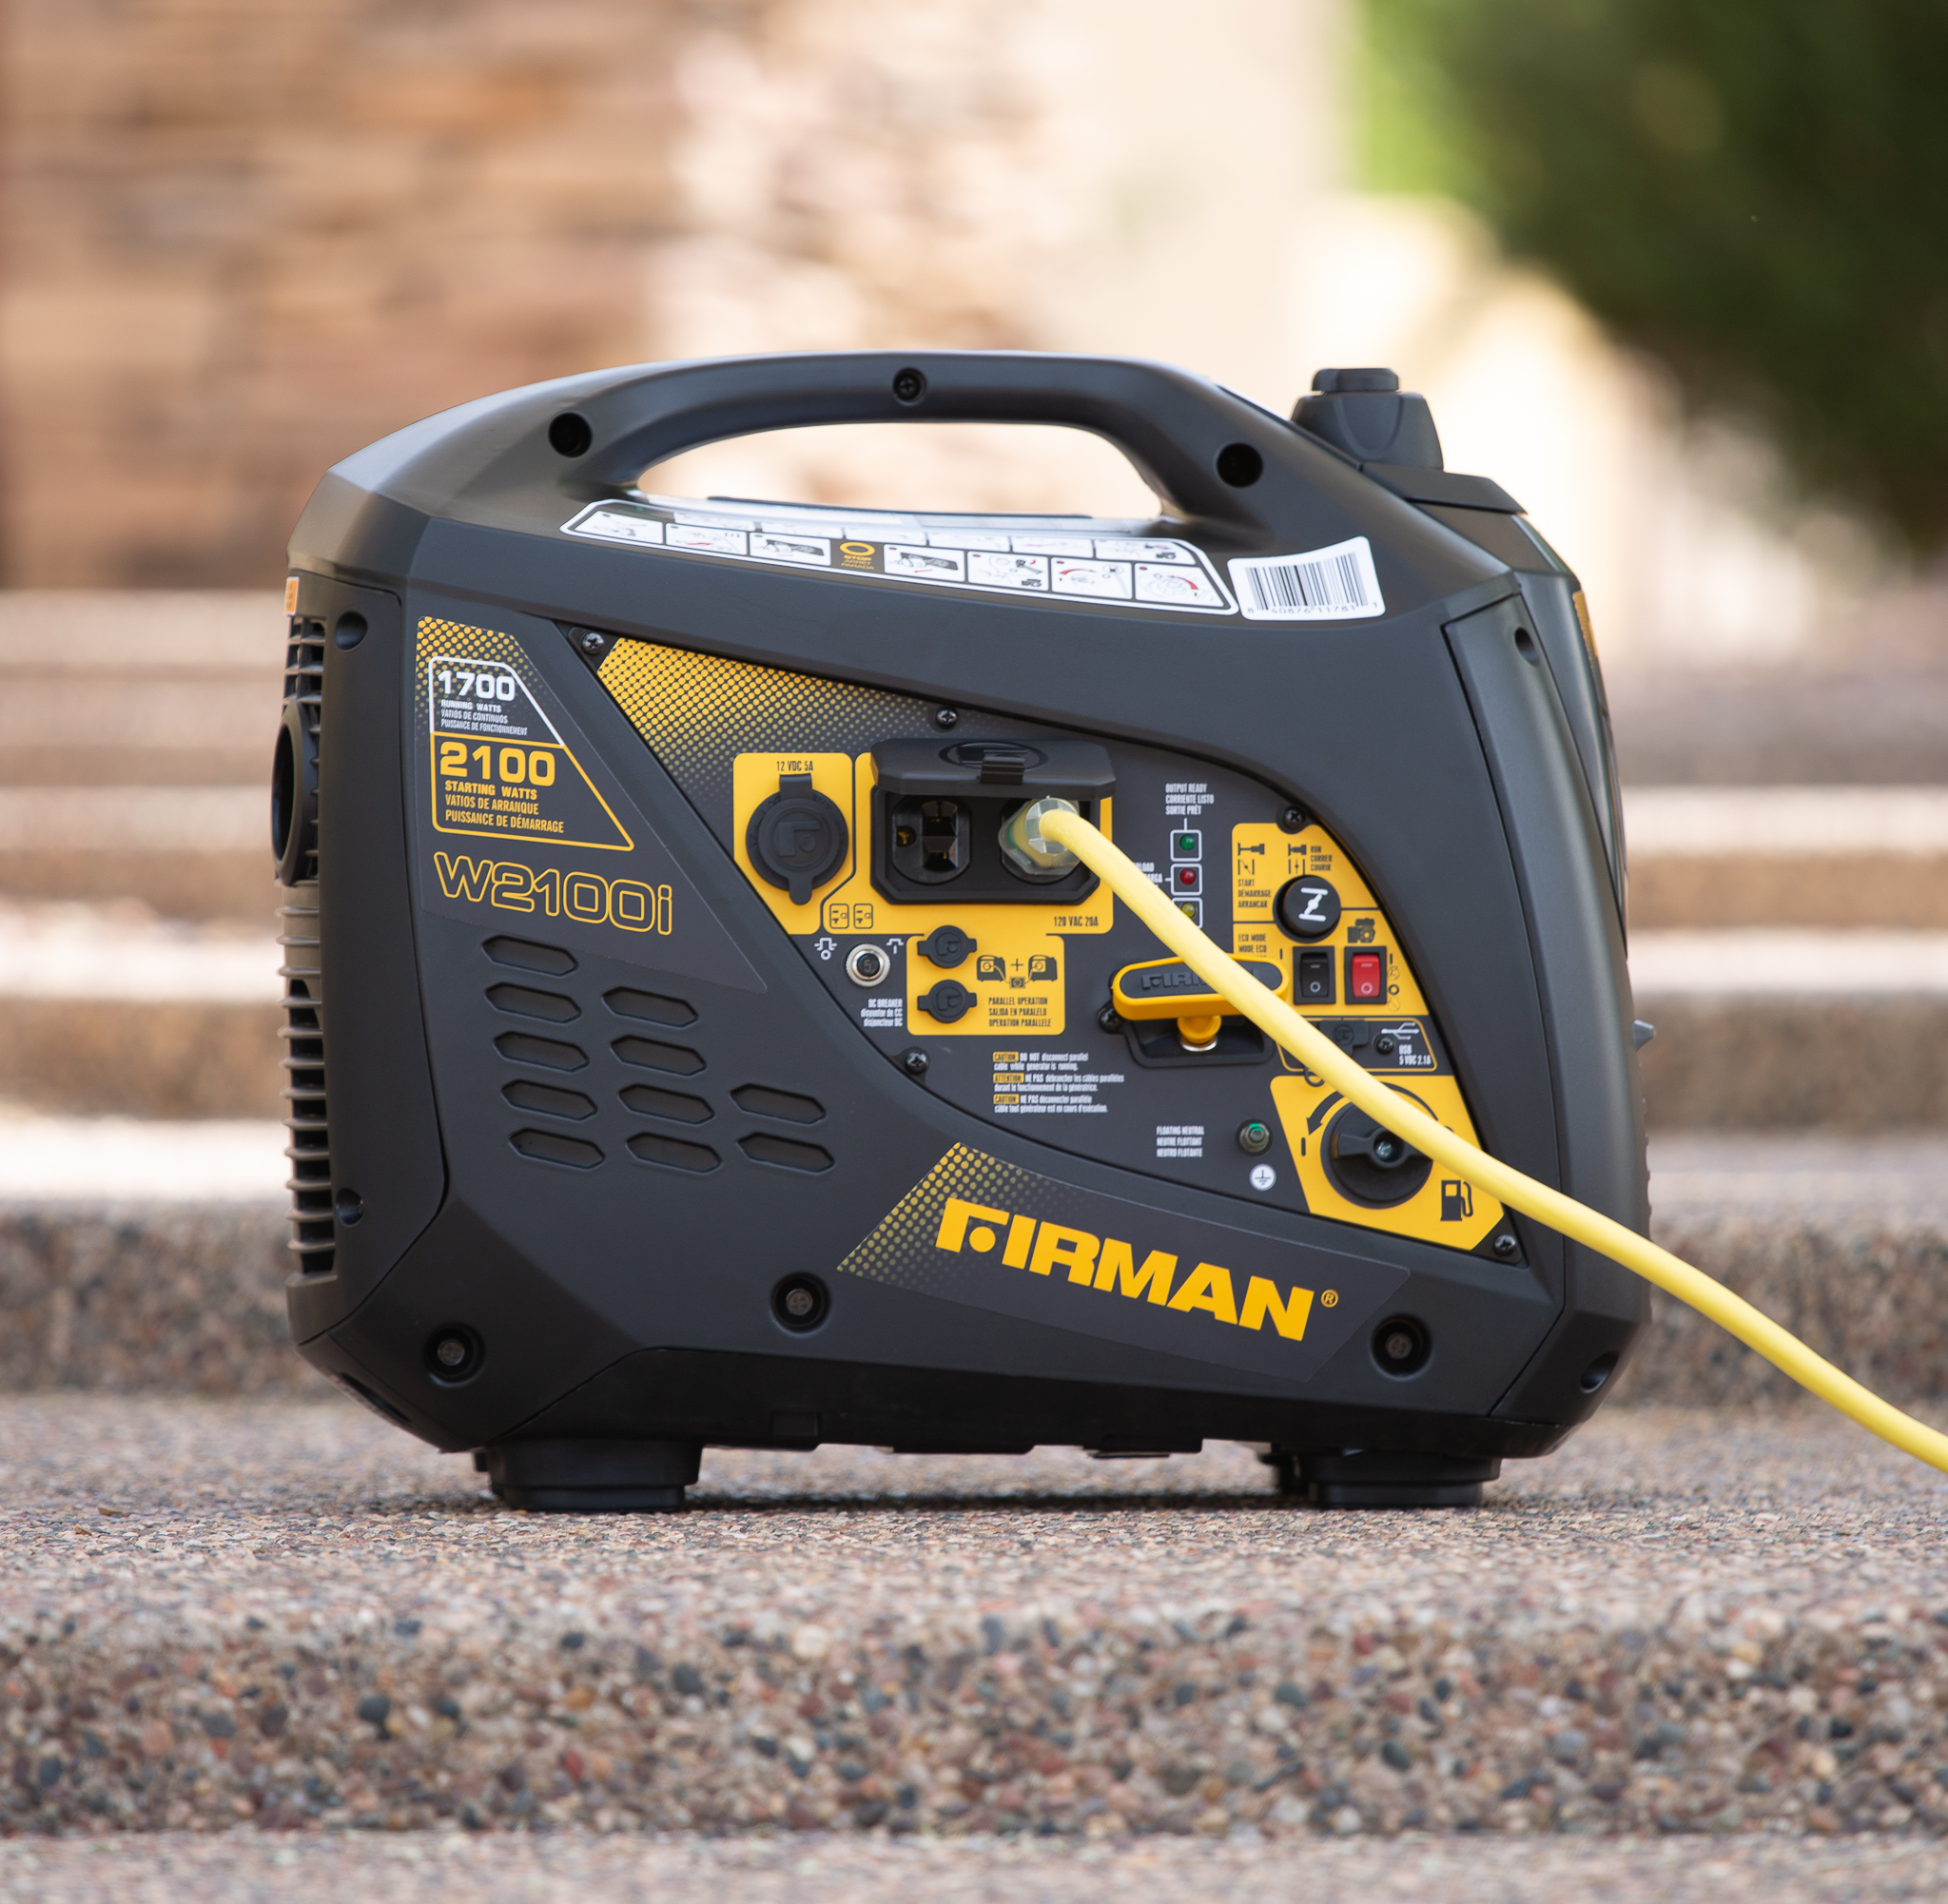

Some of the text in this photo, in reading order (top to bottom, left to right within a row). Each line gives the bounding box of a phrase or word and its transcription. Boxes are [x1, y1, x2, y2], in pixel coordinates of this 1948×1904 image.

[438, 670, 516, 702] 1700
[440, 699, 502, 713] RUNNING WATTS
[440, 709, 508, 724] VATIOS DE CONTINUOS
[471, 721, 479, 731] DE
[440, 741, 555, 787] 2100
[776, 761, 814, 771] 12 VDC 5A
[445, 780, 537, 801] STARTING WATTS
[1165, 783, 1207, 793] OUTPUT READY
[445, 794, 539, 815] VATIOS DE ARRANQUE
[1198, 793, 1215, 805] LISTO
[445, 809, 564, 833] PUISSANCE DE DÉMARRAGE
[434, 851, 673, 936] W2100i
[1054, 916, 1099, 926] 120 VAC 20A
[988, 997, 1015, 1005] PARALLEL
[1399, 1044, 1412, 1055] USB
[935, 1196, 1315, 1342] FIRMAN
